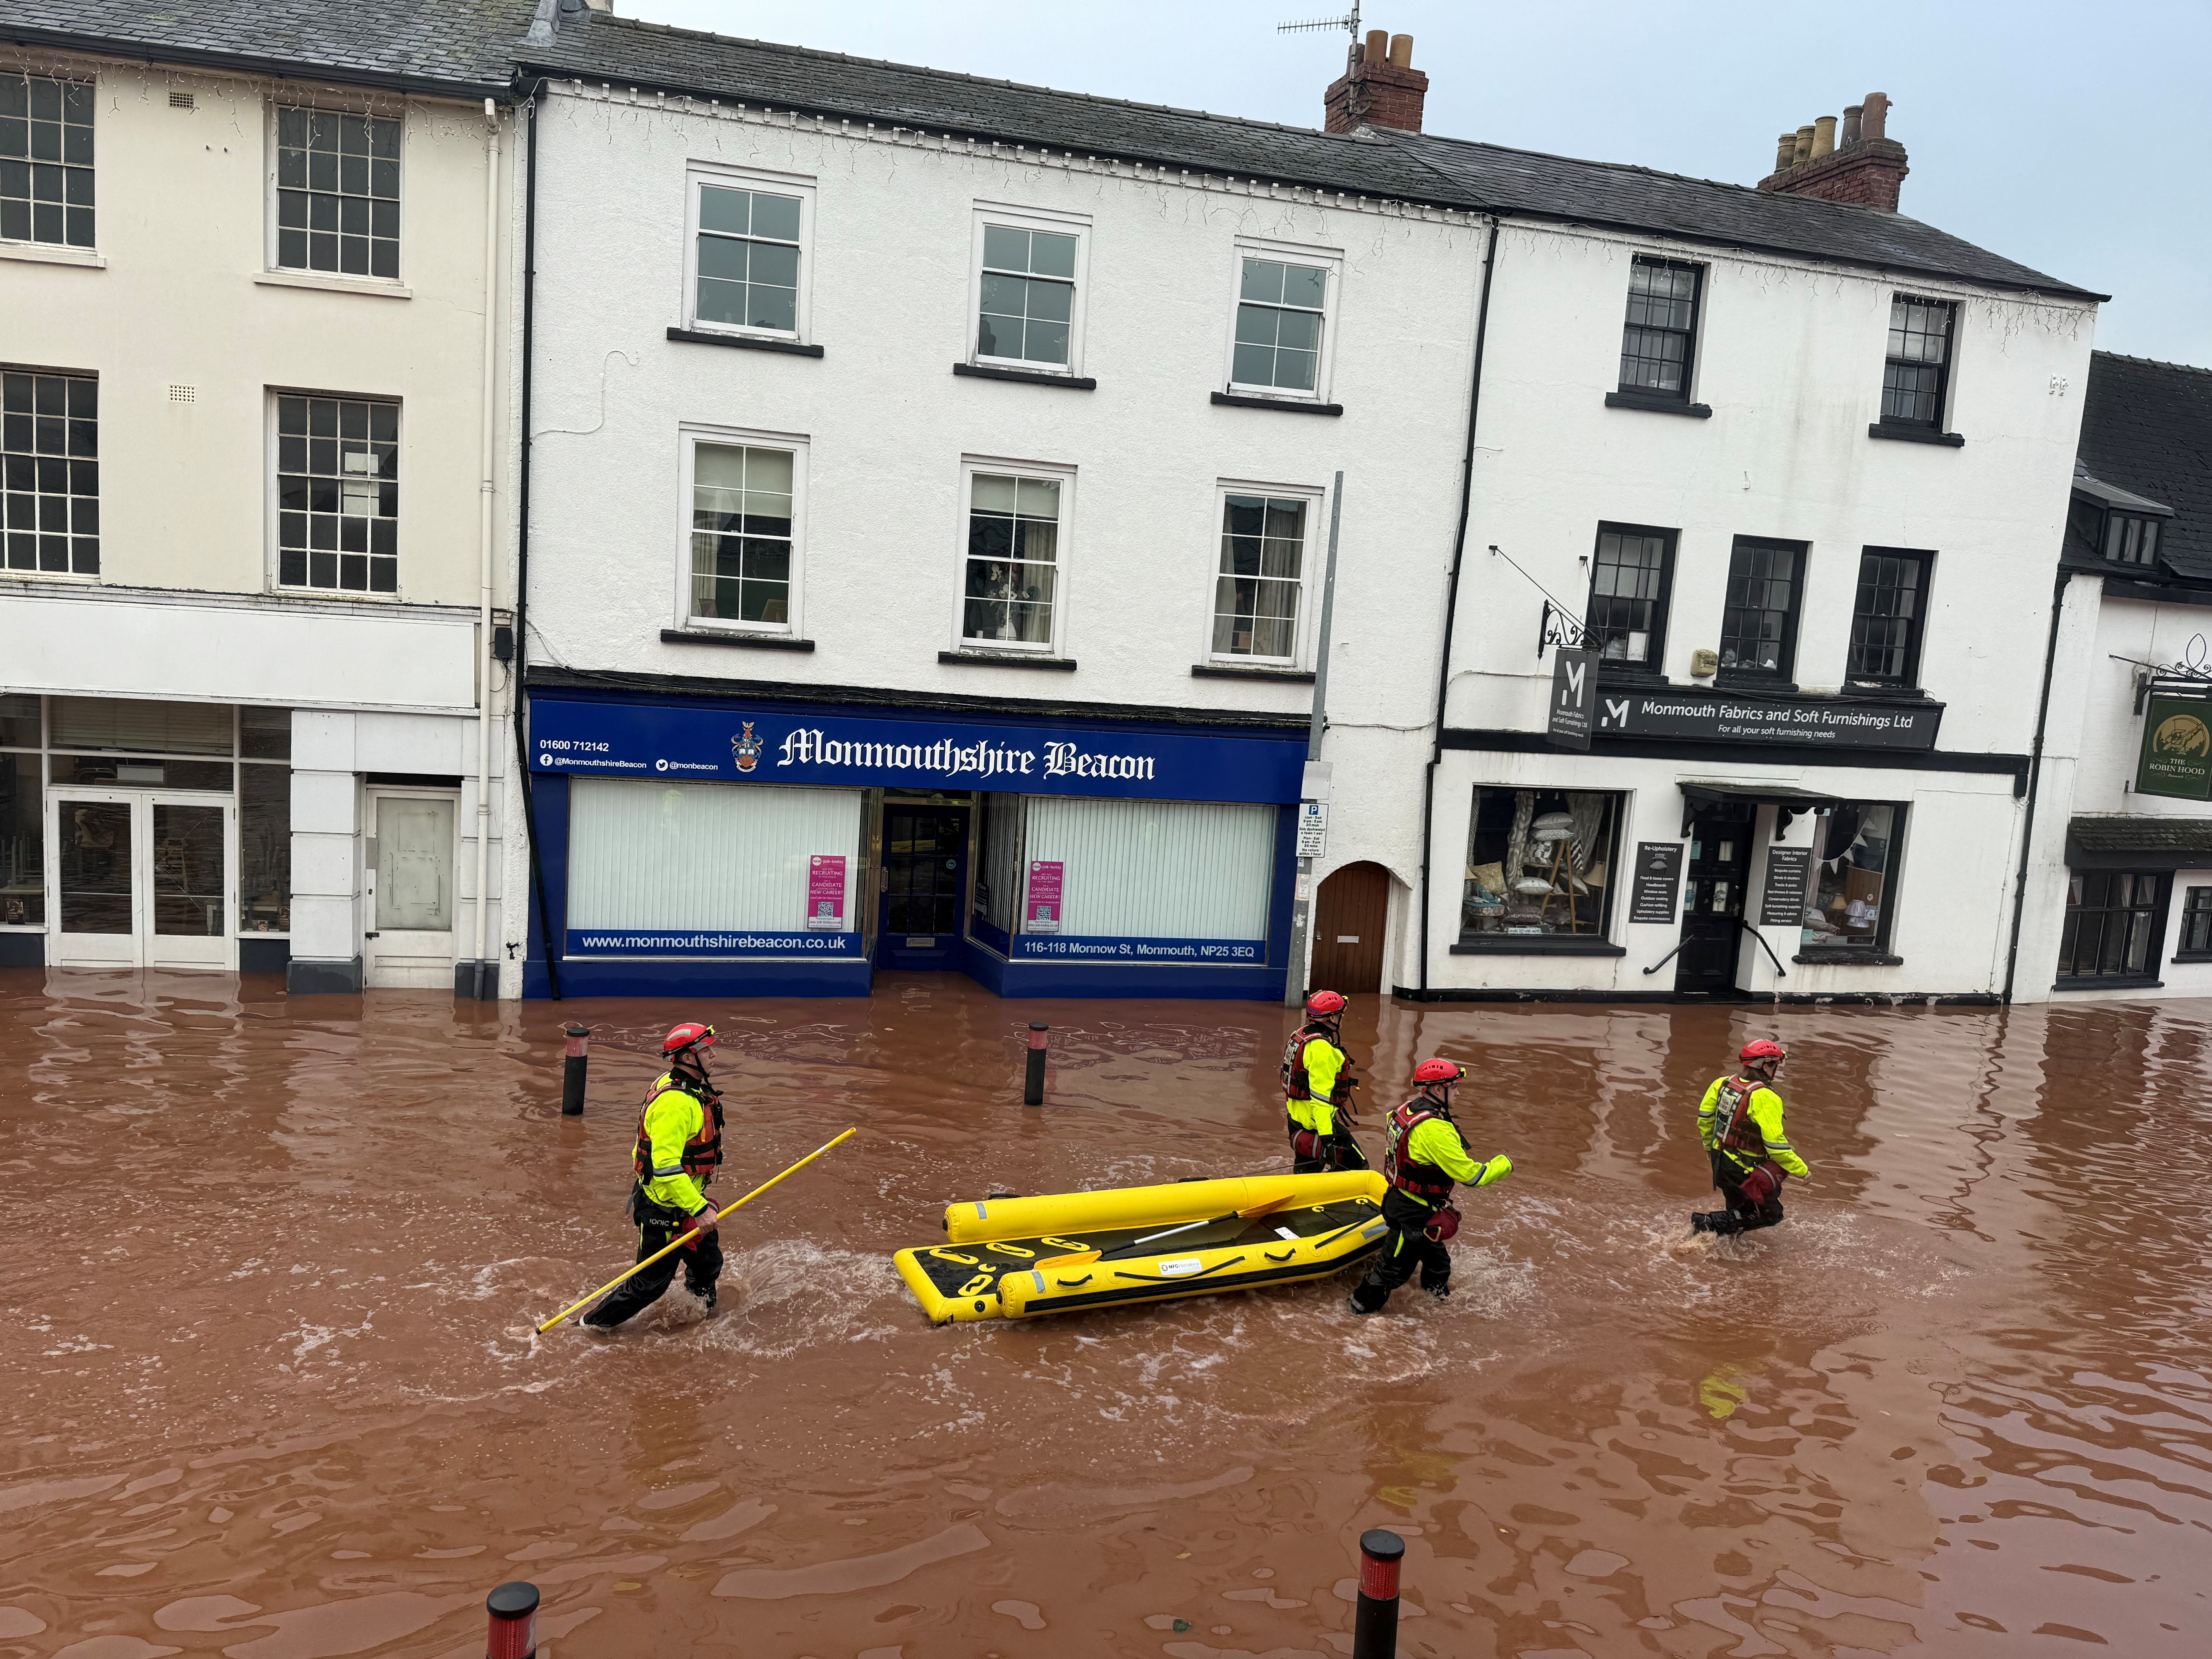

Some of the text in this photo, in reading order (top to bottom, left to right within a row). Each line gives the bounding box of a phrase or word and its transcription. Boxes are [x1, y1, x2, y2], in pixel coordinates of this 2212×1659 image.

[1557, 709, 1573, 717] Monmouth
[1642, 701, 1913, 730] Monmouth Fabrics and Soft Furnishings Ltd
[1565, 718, 1582, 728] Furnishings
[1718, 724, 1731, 733] For
[1742, 726, 1760, 735] your
[1776, 728, 1812, 738] furnishing
[540, 739, 609, 752] 01600 712142
[777, 728, 1156, 780] Monmouthshire Beacon
[555, 757, 647, 769] @MonmouthshireBeacon
[670, 761, 718, 771] @monbeacon
[2149, 763, 2205, 775] ROBIN HOOD
[582, 935, 846, 949] www.monmouthshirebeacon.co.uk
[1025, 942, 1254, 957] 116-118 Monnow St, Monmouth, NP25 3EQ
